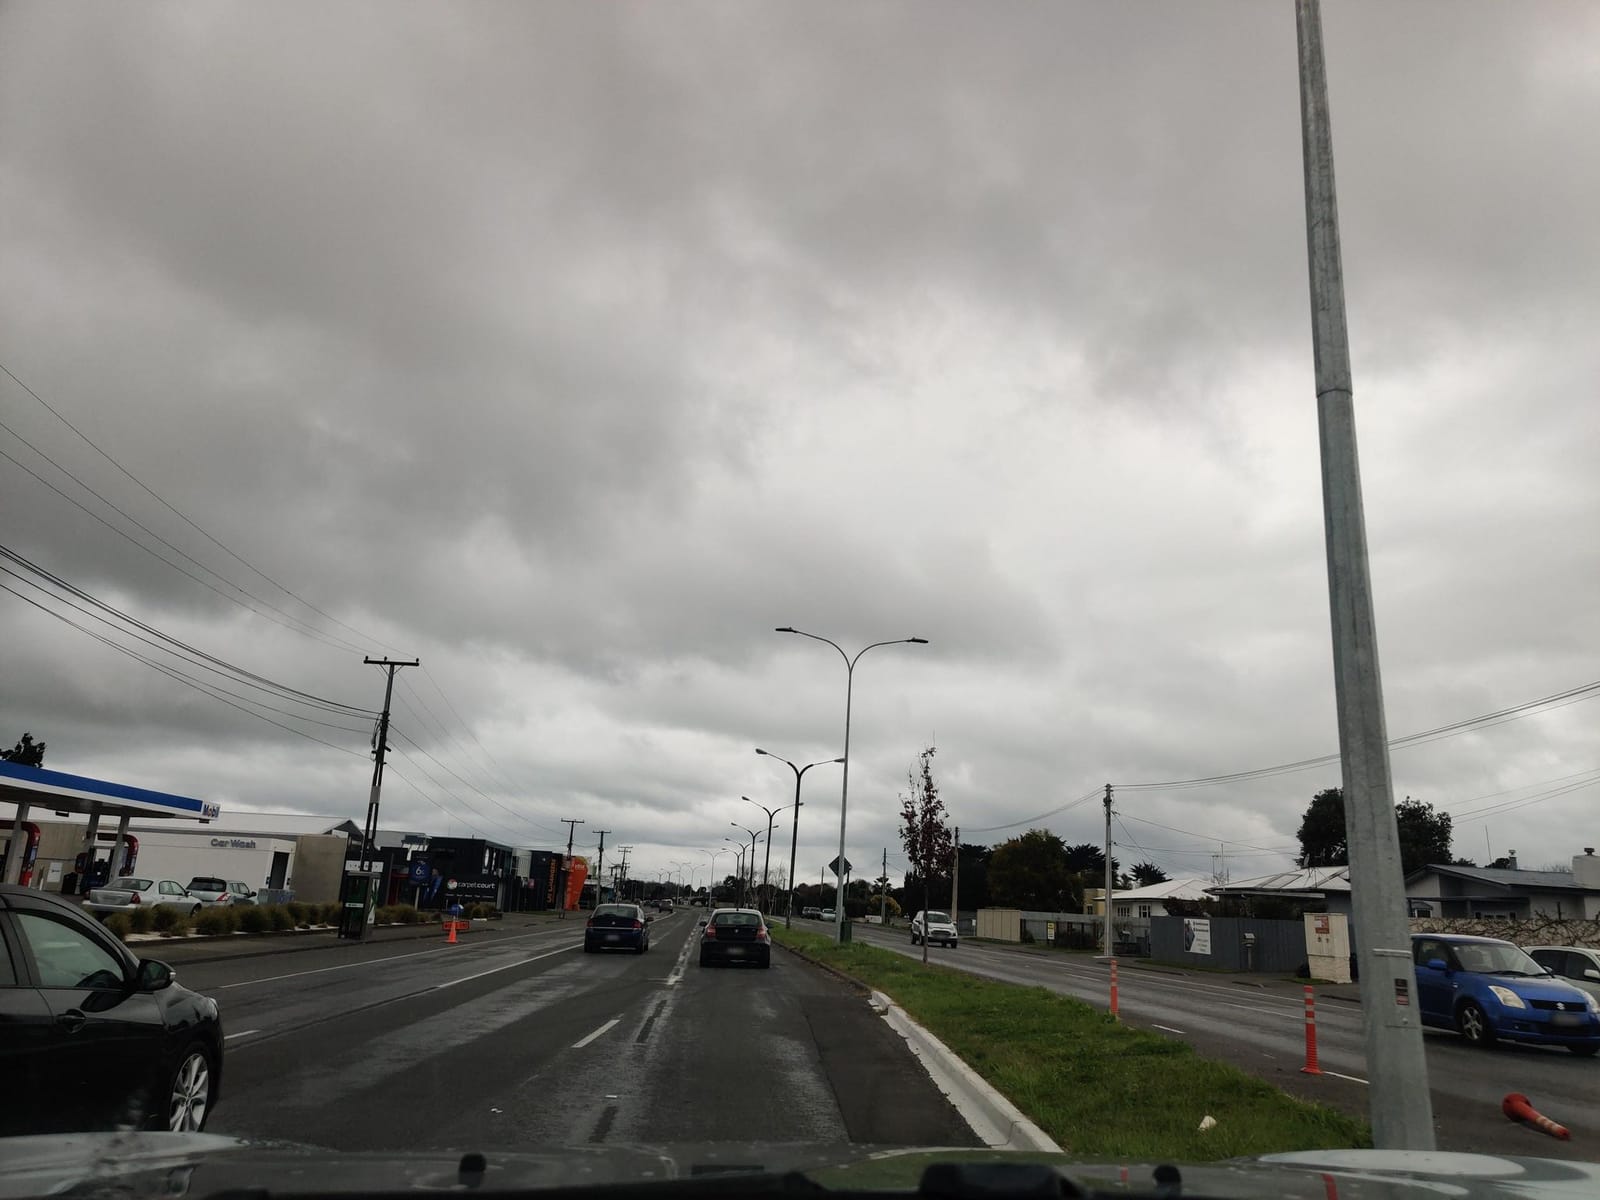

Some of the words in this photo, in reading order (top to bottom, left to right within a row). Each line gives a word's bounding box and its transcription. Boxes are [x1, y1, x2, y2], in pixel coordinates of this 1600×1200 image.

[203, 804, 220, 818] Mobil
[211, 838, 229, 847] Car
[230, 839, 256, 849] Wash
